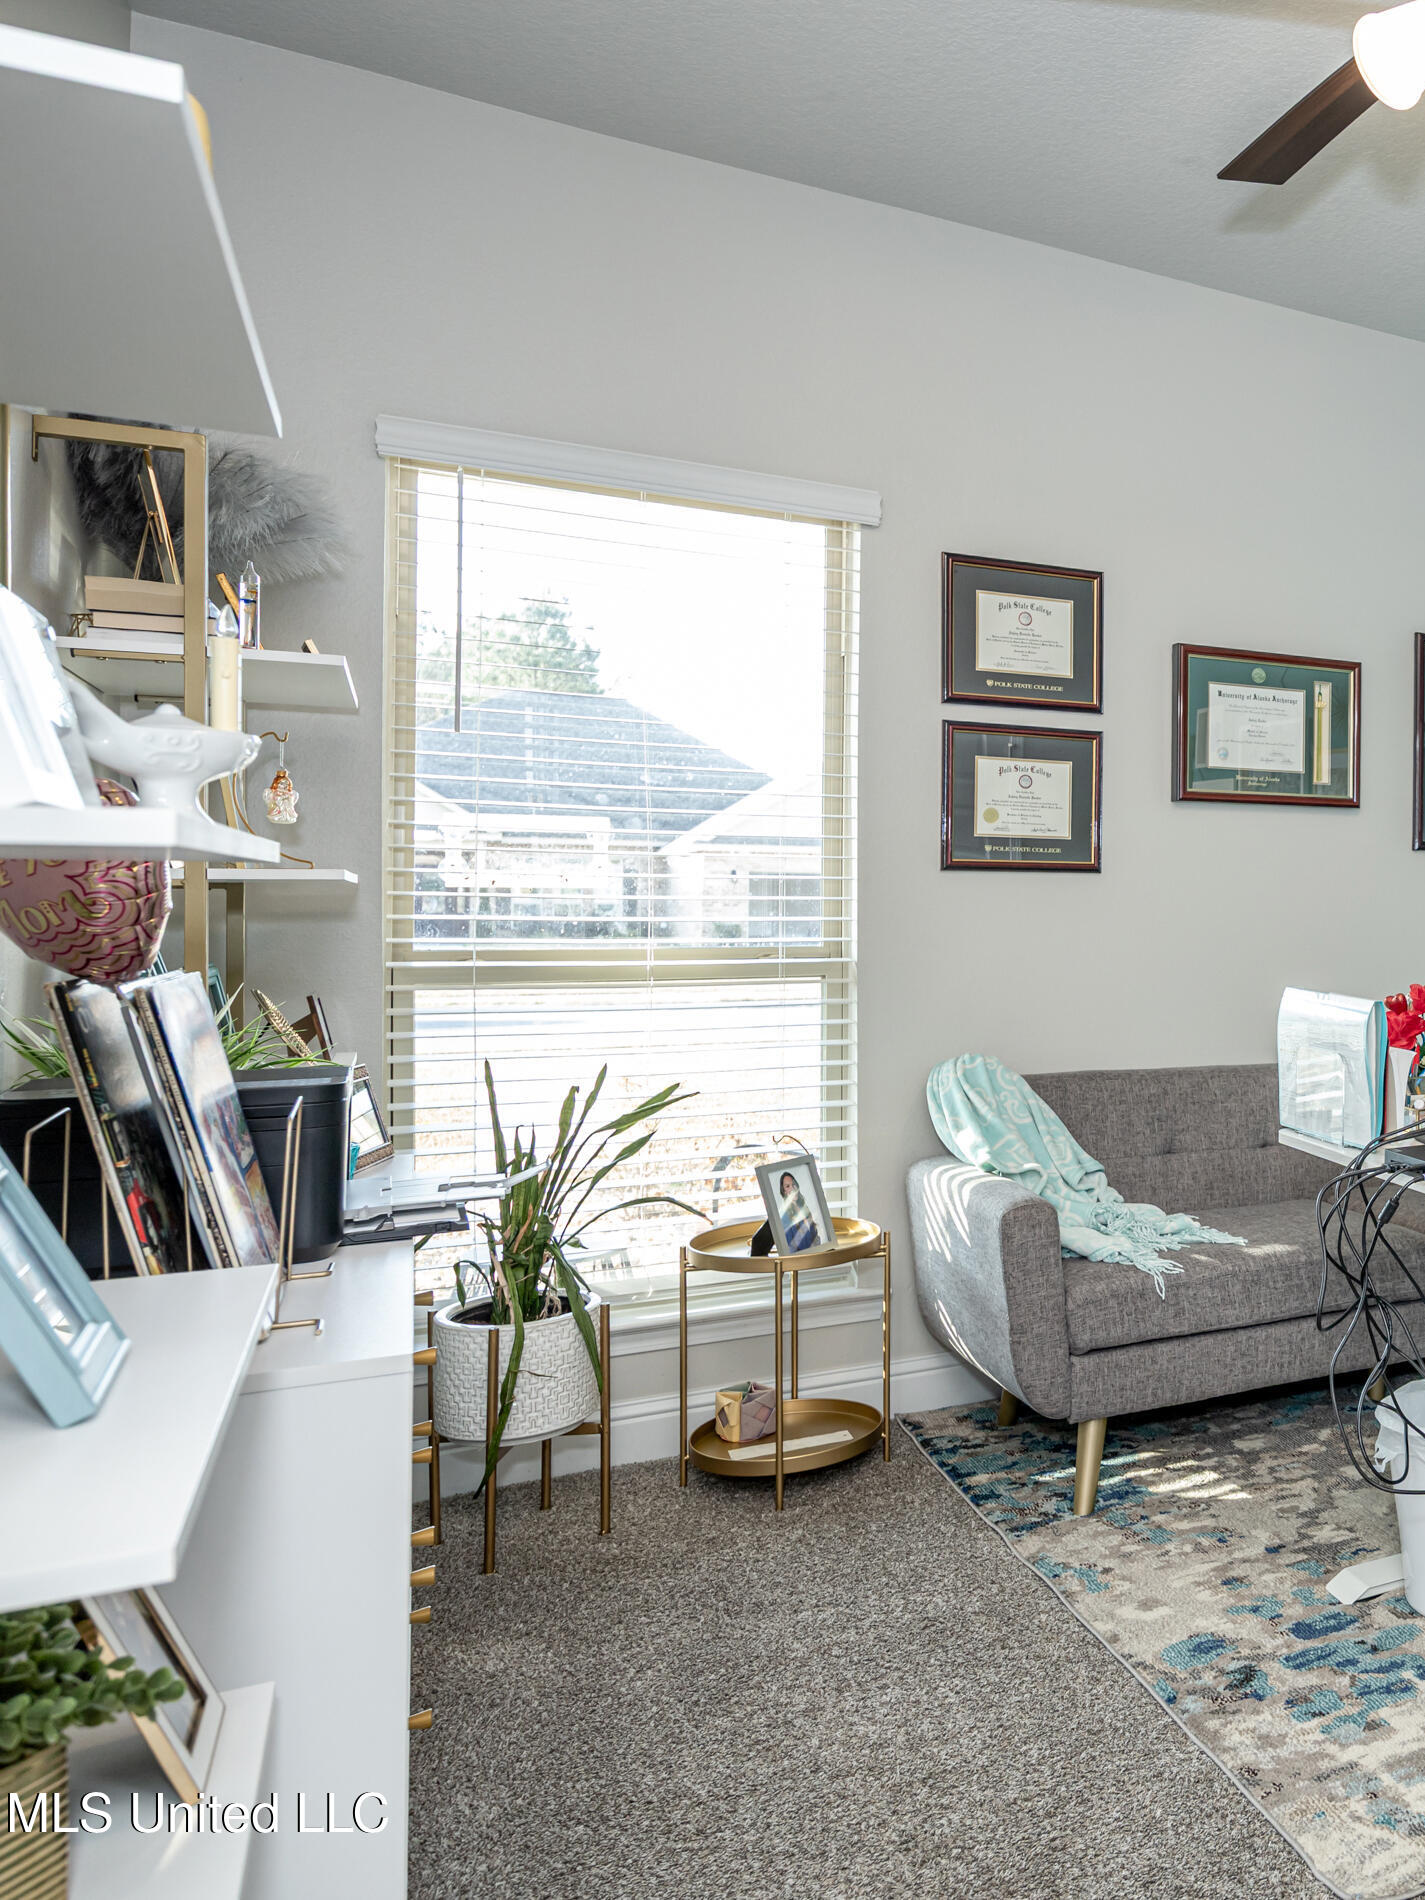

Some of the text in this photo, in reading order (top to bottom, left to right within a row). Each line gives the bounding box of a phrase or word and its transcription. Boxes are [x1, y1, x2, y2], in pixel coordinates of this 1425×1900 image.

[998, 600, 1052, 616] Polk State College
[994, 680, 1012, 688] POLK
[1033, 684, 1064, 692] COLLEGE
[998, 764, 1052, 778] Polk State College
[1031, 846, 1062, 854] COLLEGE
